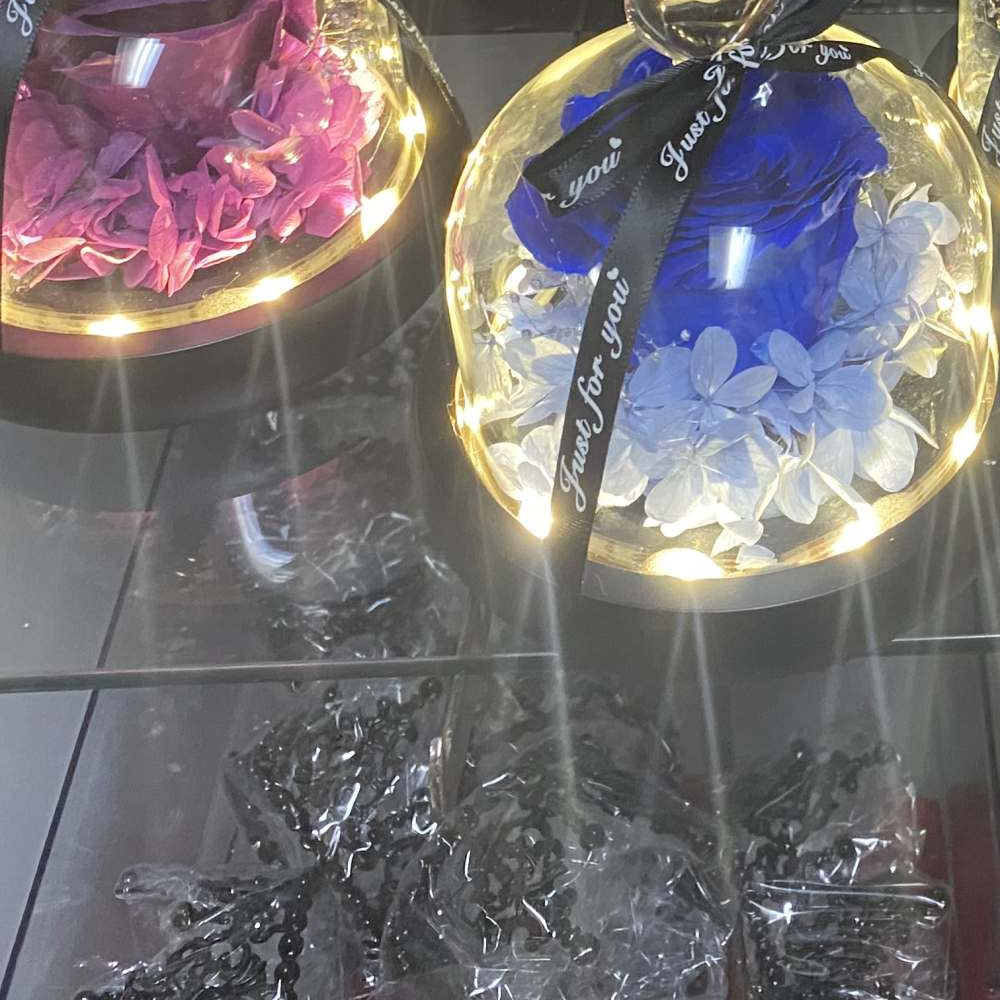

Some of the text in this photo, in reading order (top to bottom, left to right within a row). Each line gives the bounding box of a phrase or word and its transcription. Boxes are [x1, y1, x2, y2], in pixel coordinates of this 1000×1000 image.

[815, 44, 852, 66] you
[559, 150, 622, 209] you
[659, 110, 711, 183] Just
[559, 277, 631, 513] Just for you
